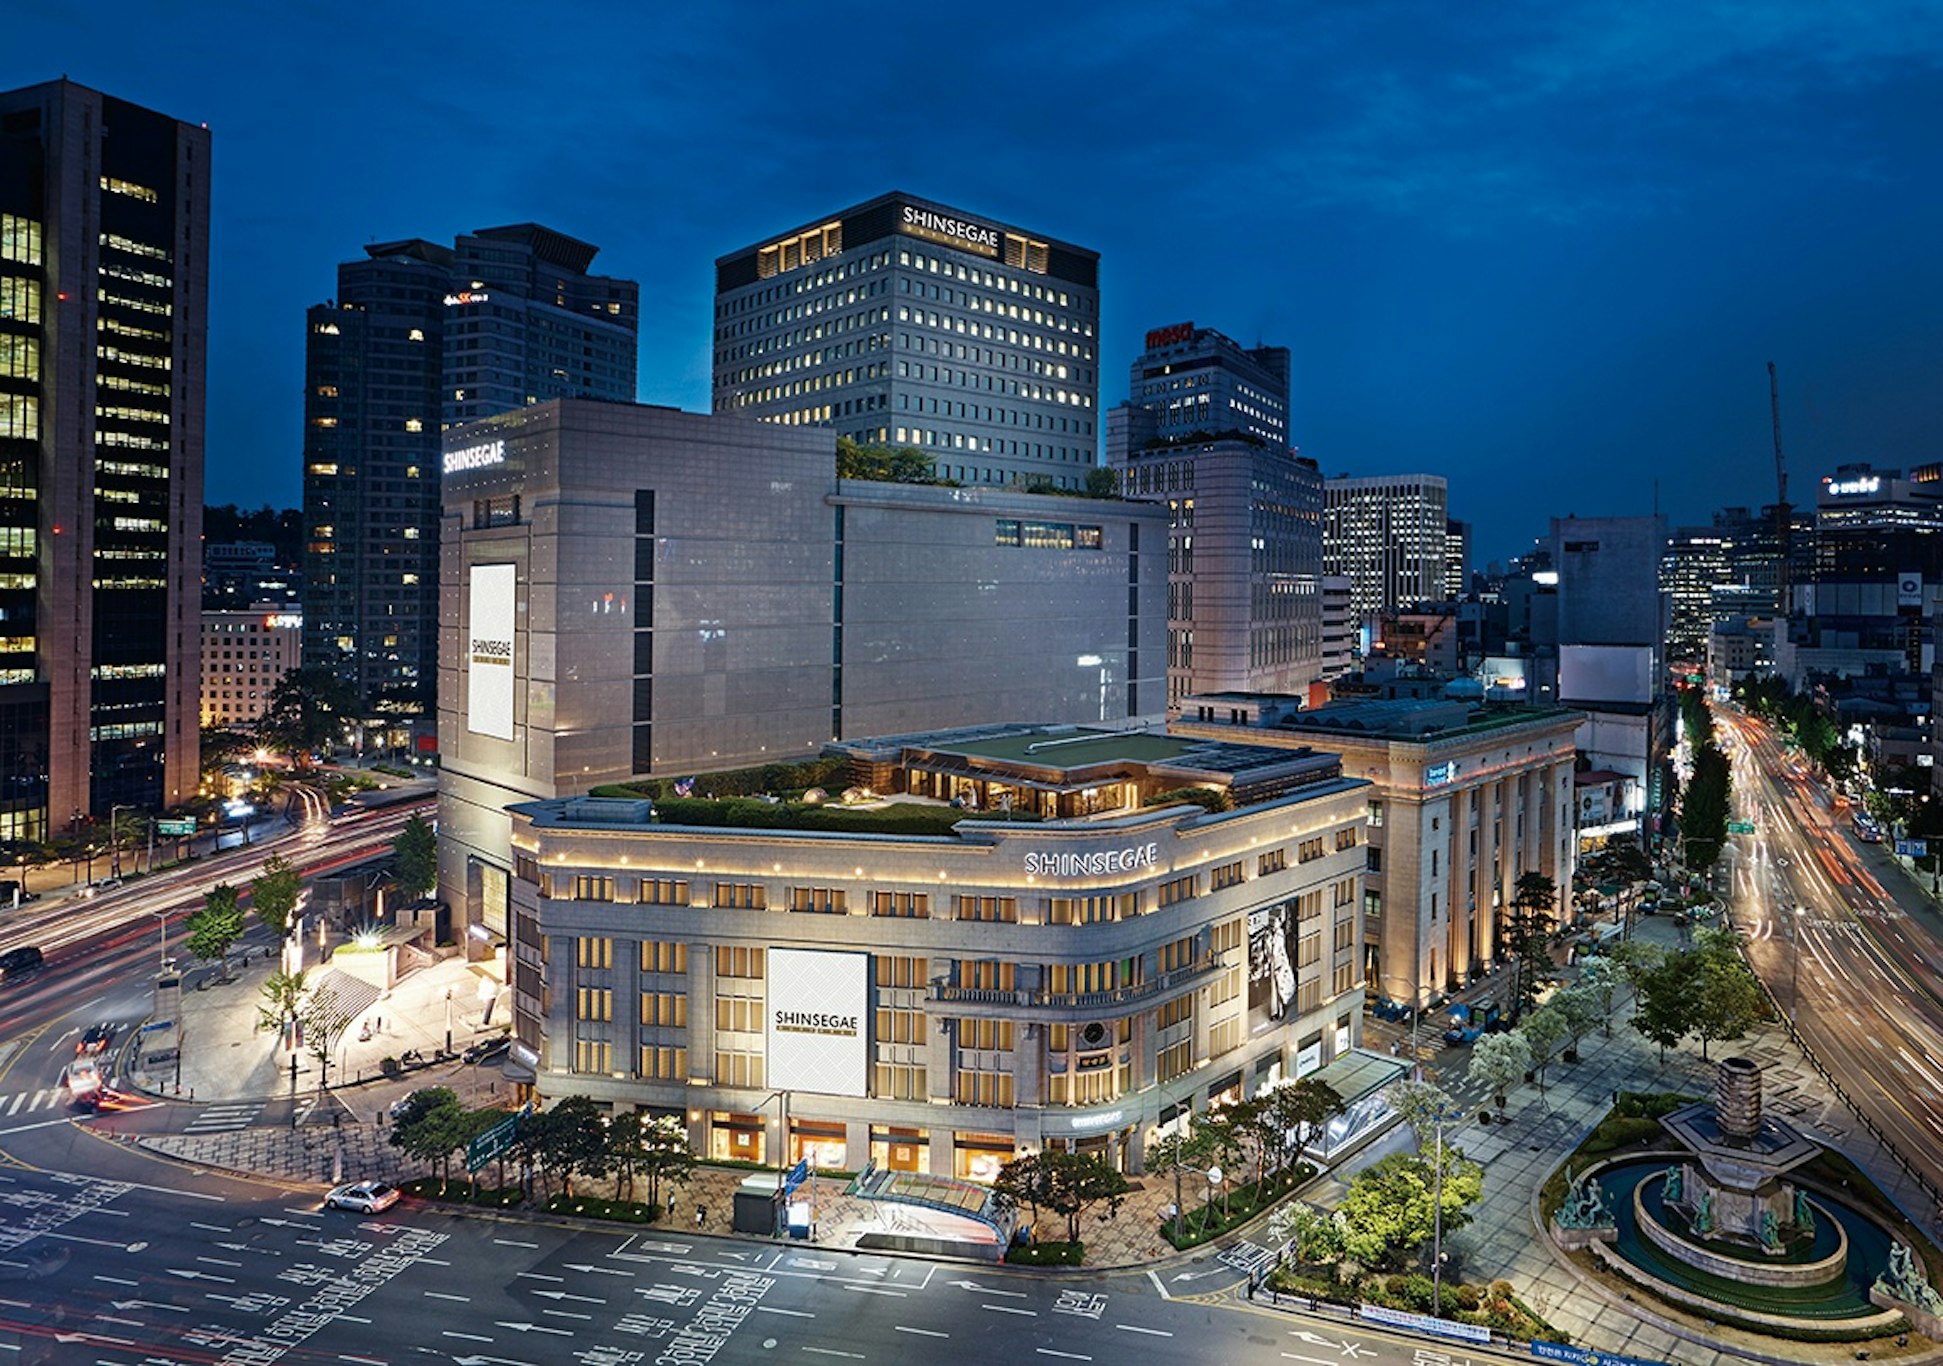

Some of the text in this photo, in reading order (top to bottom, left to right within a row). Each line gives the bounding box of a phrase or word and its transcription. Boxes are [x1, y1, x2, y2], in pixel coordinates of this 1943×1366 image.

[903, 206, 999, 248] SHINSEGAE
[443, 440, 506, 474] SHINSEGAE
[1024, 842, 1157, 876] SHINSEGAE
[775, 1010, 858, 1030] SHINSEGAE
